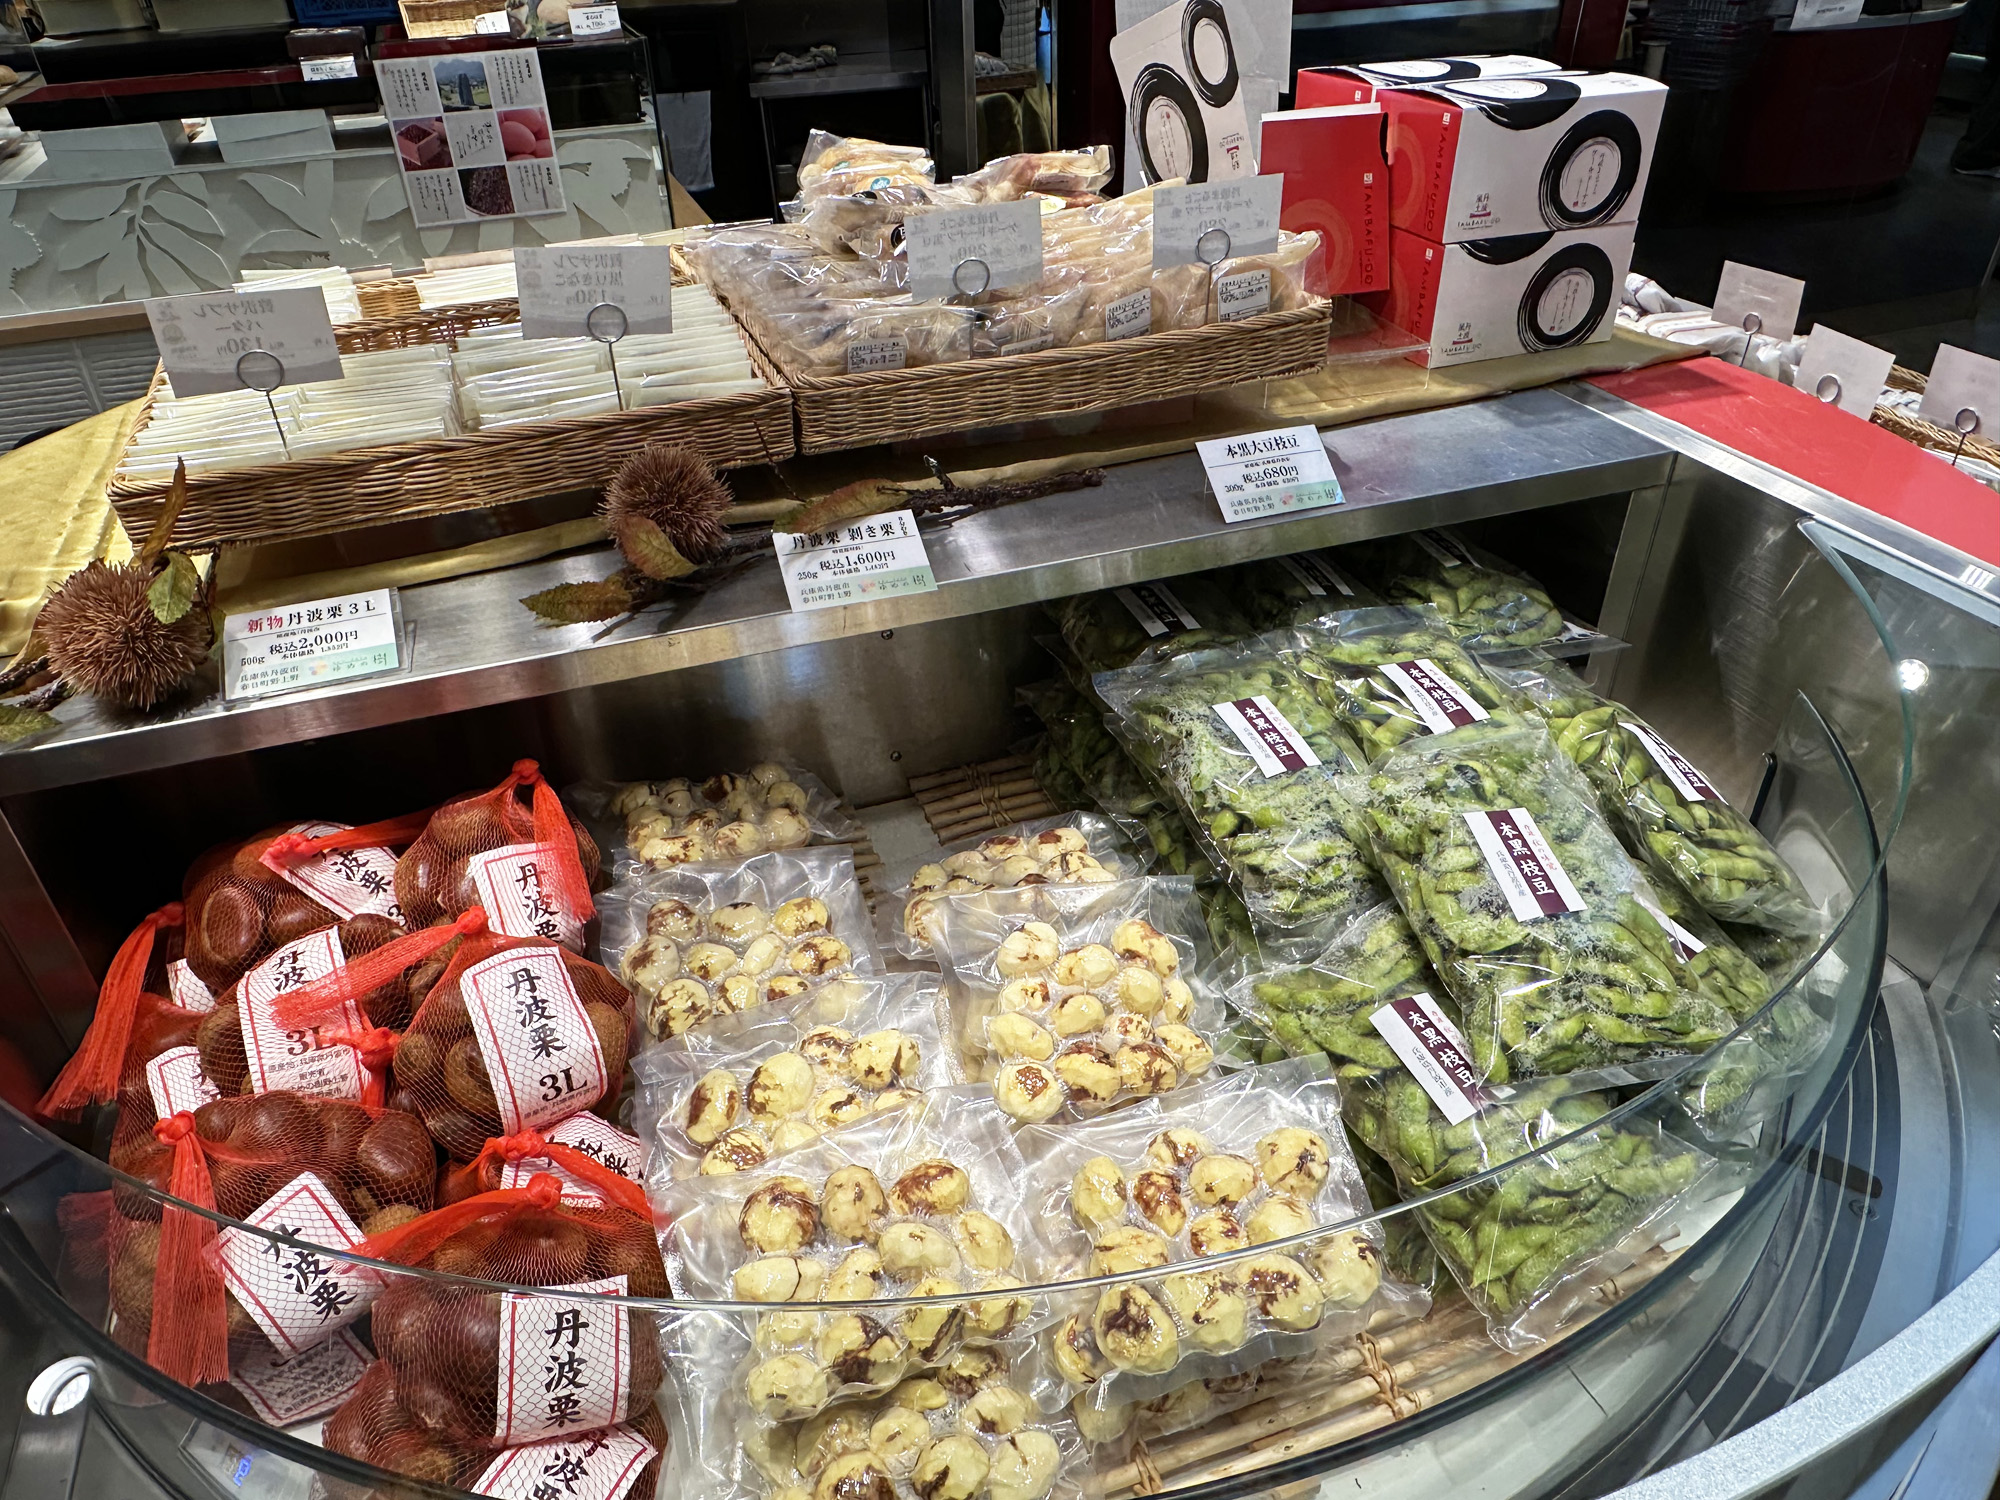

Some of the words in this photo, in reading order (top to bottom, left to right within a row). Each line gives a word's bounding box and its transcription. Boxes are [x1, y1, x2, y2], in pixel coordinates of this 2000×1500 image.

[1363, 185, 1373, 285] TAMBAFU-DO
[1226, 434, 1300, 459] 本黒大豆枝豆
[1225, 483, 1245, 493] 300g
[1242, 465, 1299, 484] 税込680円
[793, 530, 841, 550] 丹波栗
[797, 571, 818, 581] 250g
[819, 550, 896, 571] 税込1,600円
[269, 630, 358, 655] 税込2,000円
[241, 656, 265, 667] 500g
[1409, 668, 1462, 713] 本黒枝豆
[1245, 707, 1295, 757] 本黒枝豆
[1499, 822, 1555, 895] 本黒枝豆
[505, 966, 568, 1061] 丹波栗
[286, 1025, 337, 1056] 3L
[1408, 1011, 1476, 1088] 本黒枝豆
[539, 1066, 589, 1102] 3L
[542, 1308, 590, 1430] 丹波栗
